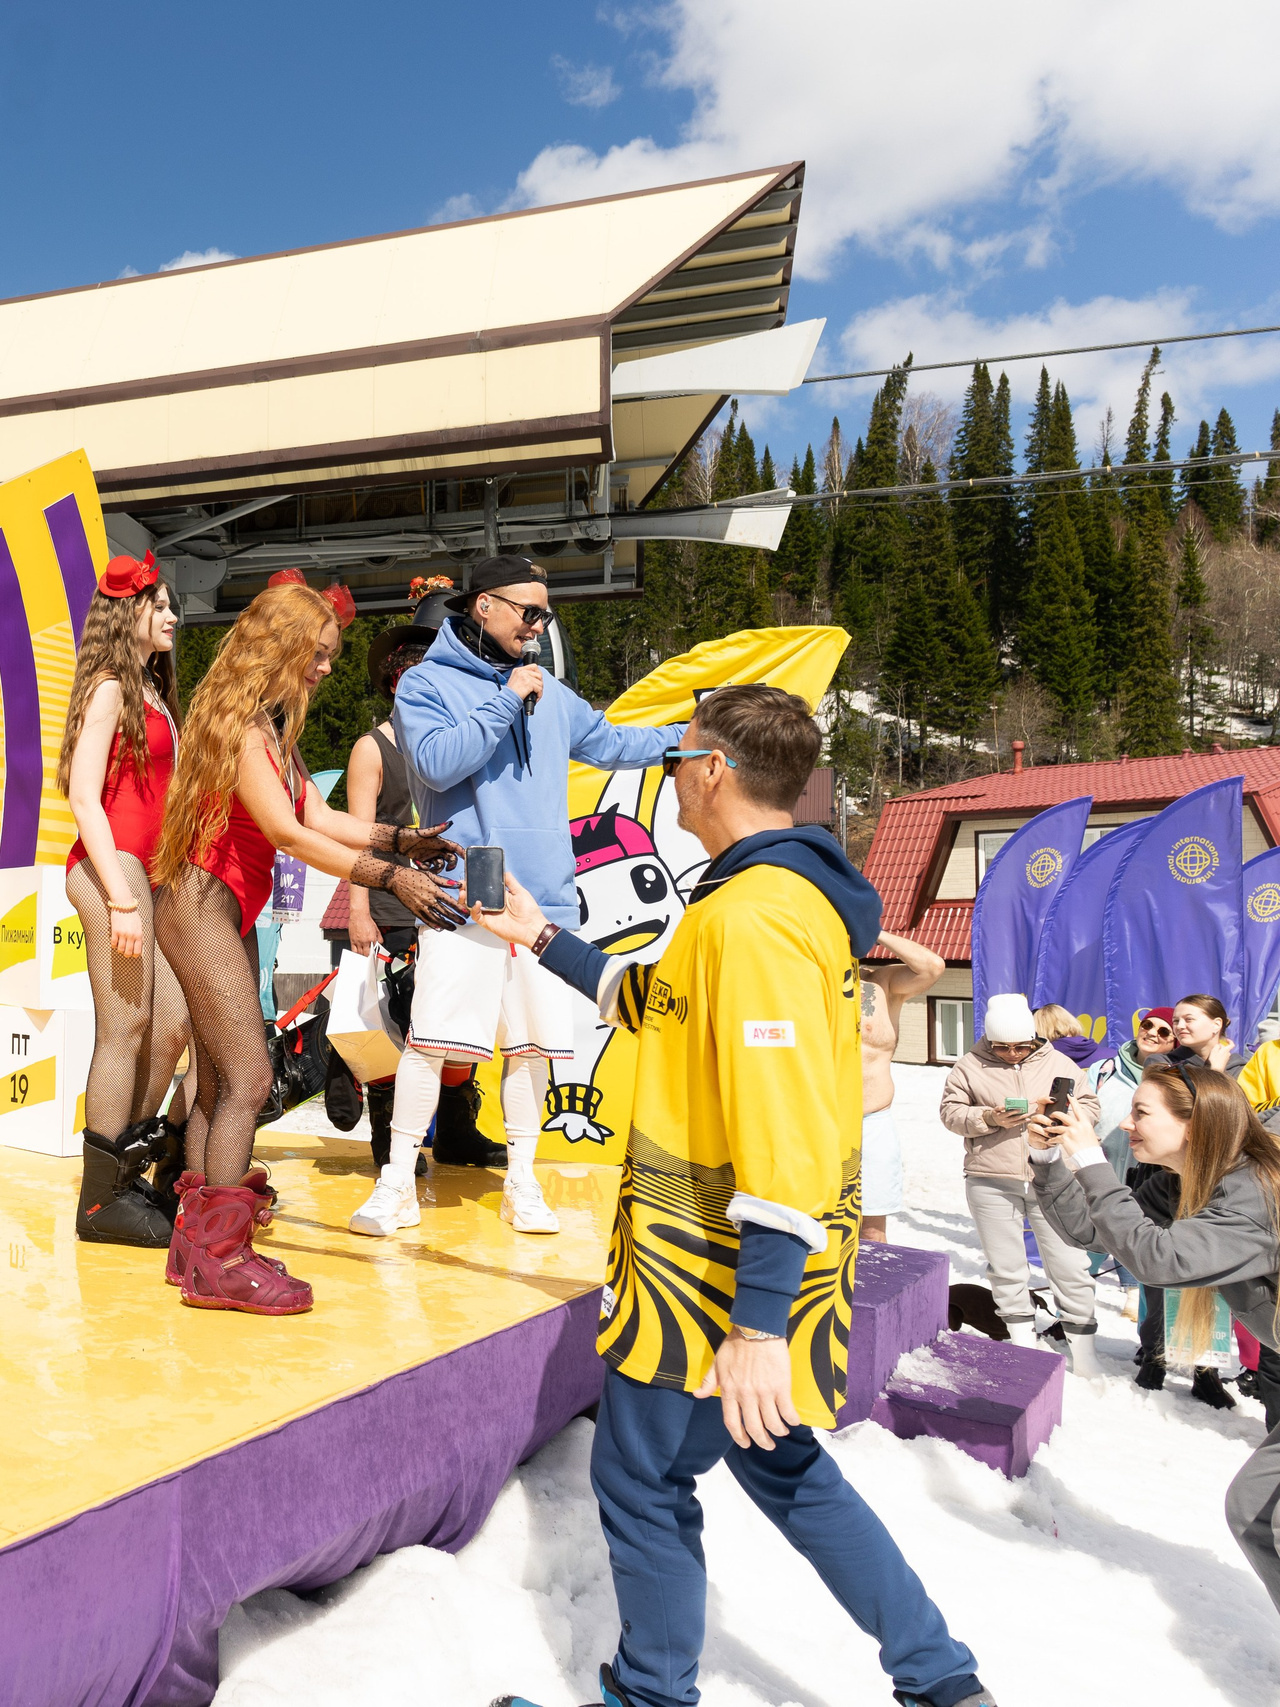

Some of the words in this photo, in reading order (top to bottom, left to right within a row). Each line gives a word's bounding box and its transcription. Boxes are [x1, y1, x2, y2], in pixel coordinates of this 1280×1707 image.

[1030, 847, 1063, 873] international
[1172, 836, 1220, 867] international
[1166, 855, 1215, 885] international
[281, 895, 295, 904] 217
[1, 925, 35, 945] Пижамный
[53, 926, 62, 944] В
[67, 930, 85, 950] ку
[648, 994, 657, 1005] ST
[652, 982, 668, 998] ELKA
[11, 1033, 30, 1056] ПТ
[753, 1027, 786, 1040] AYS!
[10, 1073, 29, 1104] 19
